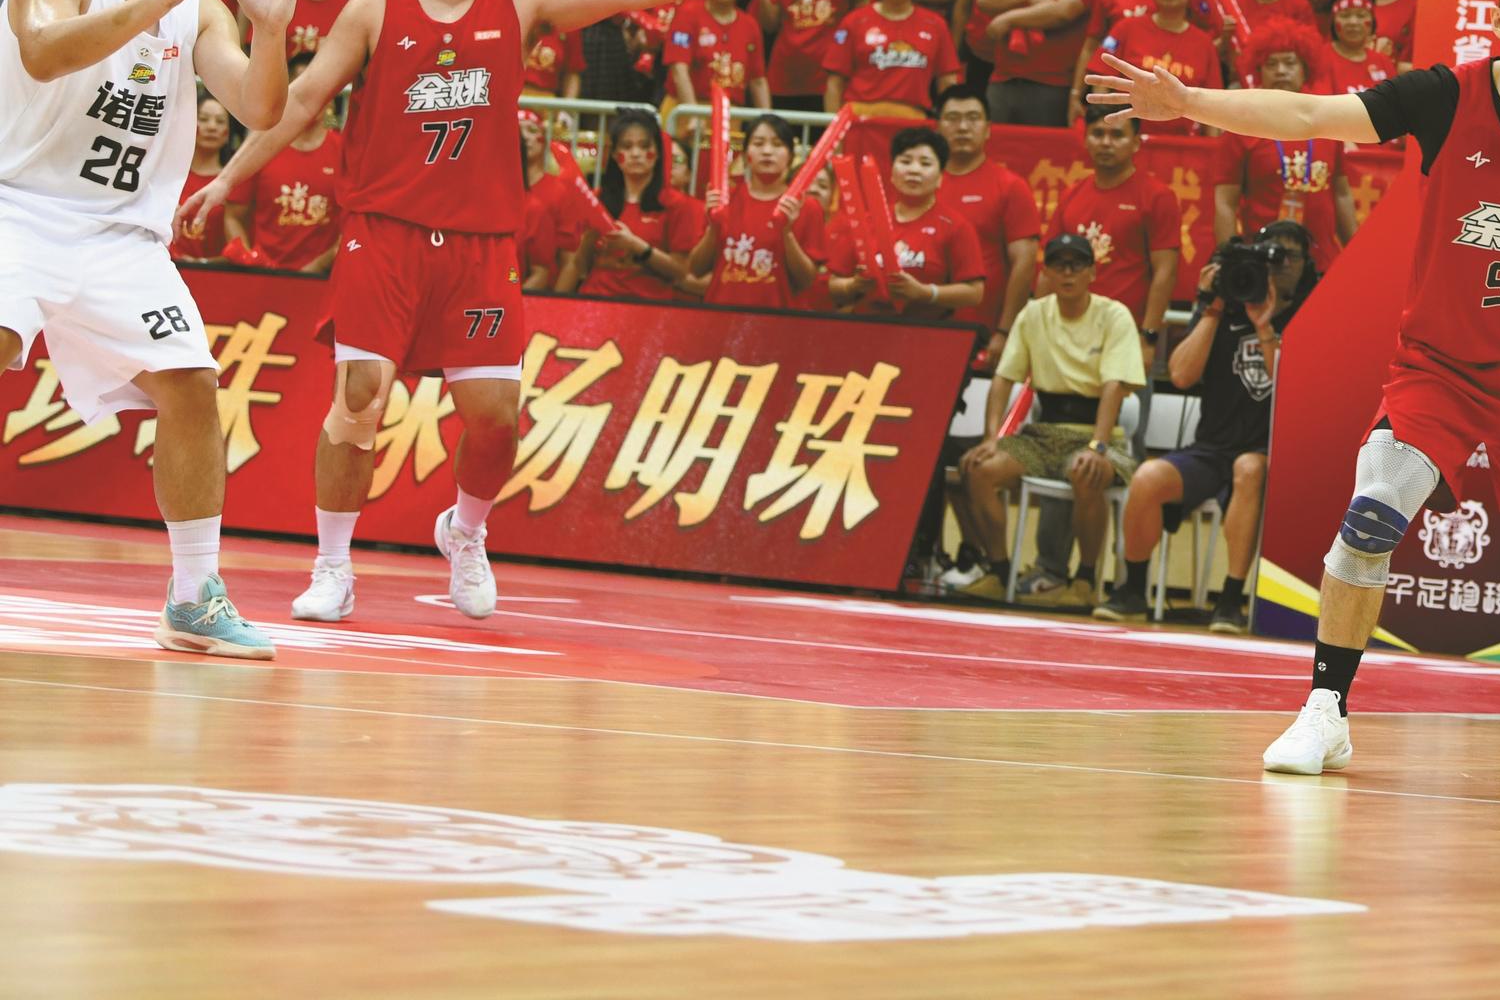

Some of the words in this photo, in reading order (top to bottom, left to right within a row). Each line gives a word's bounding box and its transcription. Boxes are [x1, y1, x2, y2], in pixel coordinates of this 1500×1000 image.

[86, 79, 167, 137] 诸暨
[403, 67, 492, 114] 余姚
[79, 134, 147, 193] 28
[421, 117, 474, 165] 77
[141, 305, 191, 341] 28
[463, 306, 505, 340] 77
